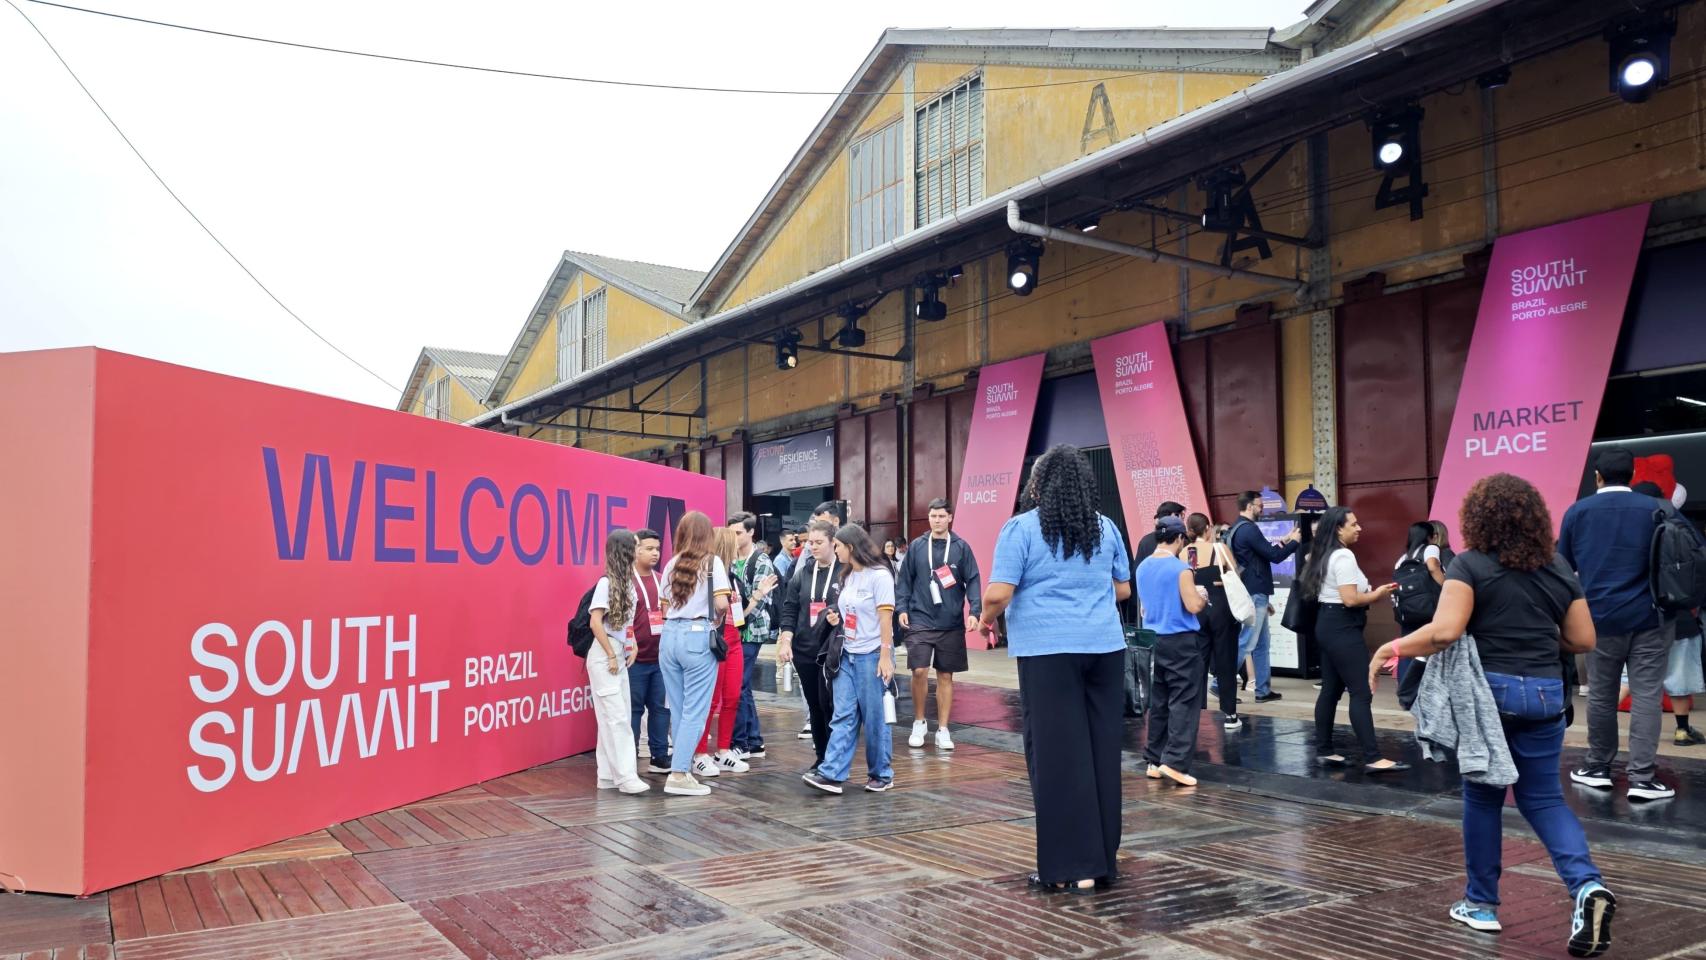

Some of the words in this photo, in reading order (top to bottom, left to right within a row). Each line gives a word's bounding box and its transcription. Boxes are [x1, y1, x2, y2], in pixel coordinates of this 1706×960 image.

[1081, 82, 1120, 154] A
[1511, 257, 1575, 283] SOUTH
[1511, 269, 1588, 297] SUMMIT
[1511, 298, 1547, 311] BRAZIL
[1511, 308, 1546, 321] PORTO
[1547, 301, 1588, 315] ALEGRE
[1115, 351, 1148, 368] SOUTH
[1115, 359, 1154, 378] SUMMIT
[986, 382, 1014, 395] SOUTH
[1473, 400, 1583, 432] MARKET
[758, 444, 785, 458] BEYOND
[1465, 431, 1547, 458] PLACE
[1126, 458, 1161, 471] BEYOND
[1131, 465, 1183, 480] RESILIENCE
[967, 472, 1013, 488] MARKET
[1134, 475, 1186, 488] RESILIENCE
[963, 489, 997, 504] PLACE
[189, 614, 417, 703] SOUTH
[465, 650, 538, 688] BRAZIL
[464, 696, 534, 737] PORTO
[538, 685, 594, 720] ALEGR
[187, 680, 450, 793] SUMMIT
